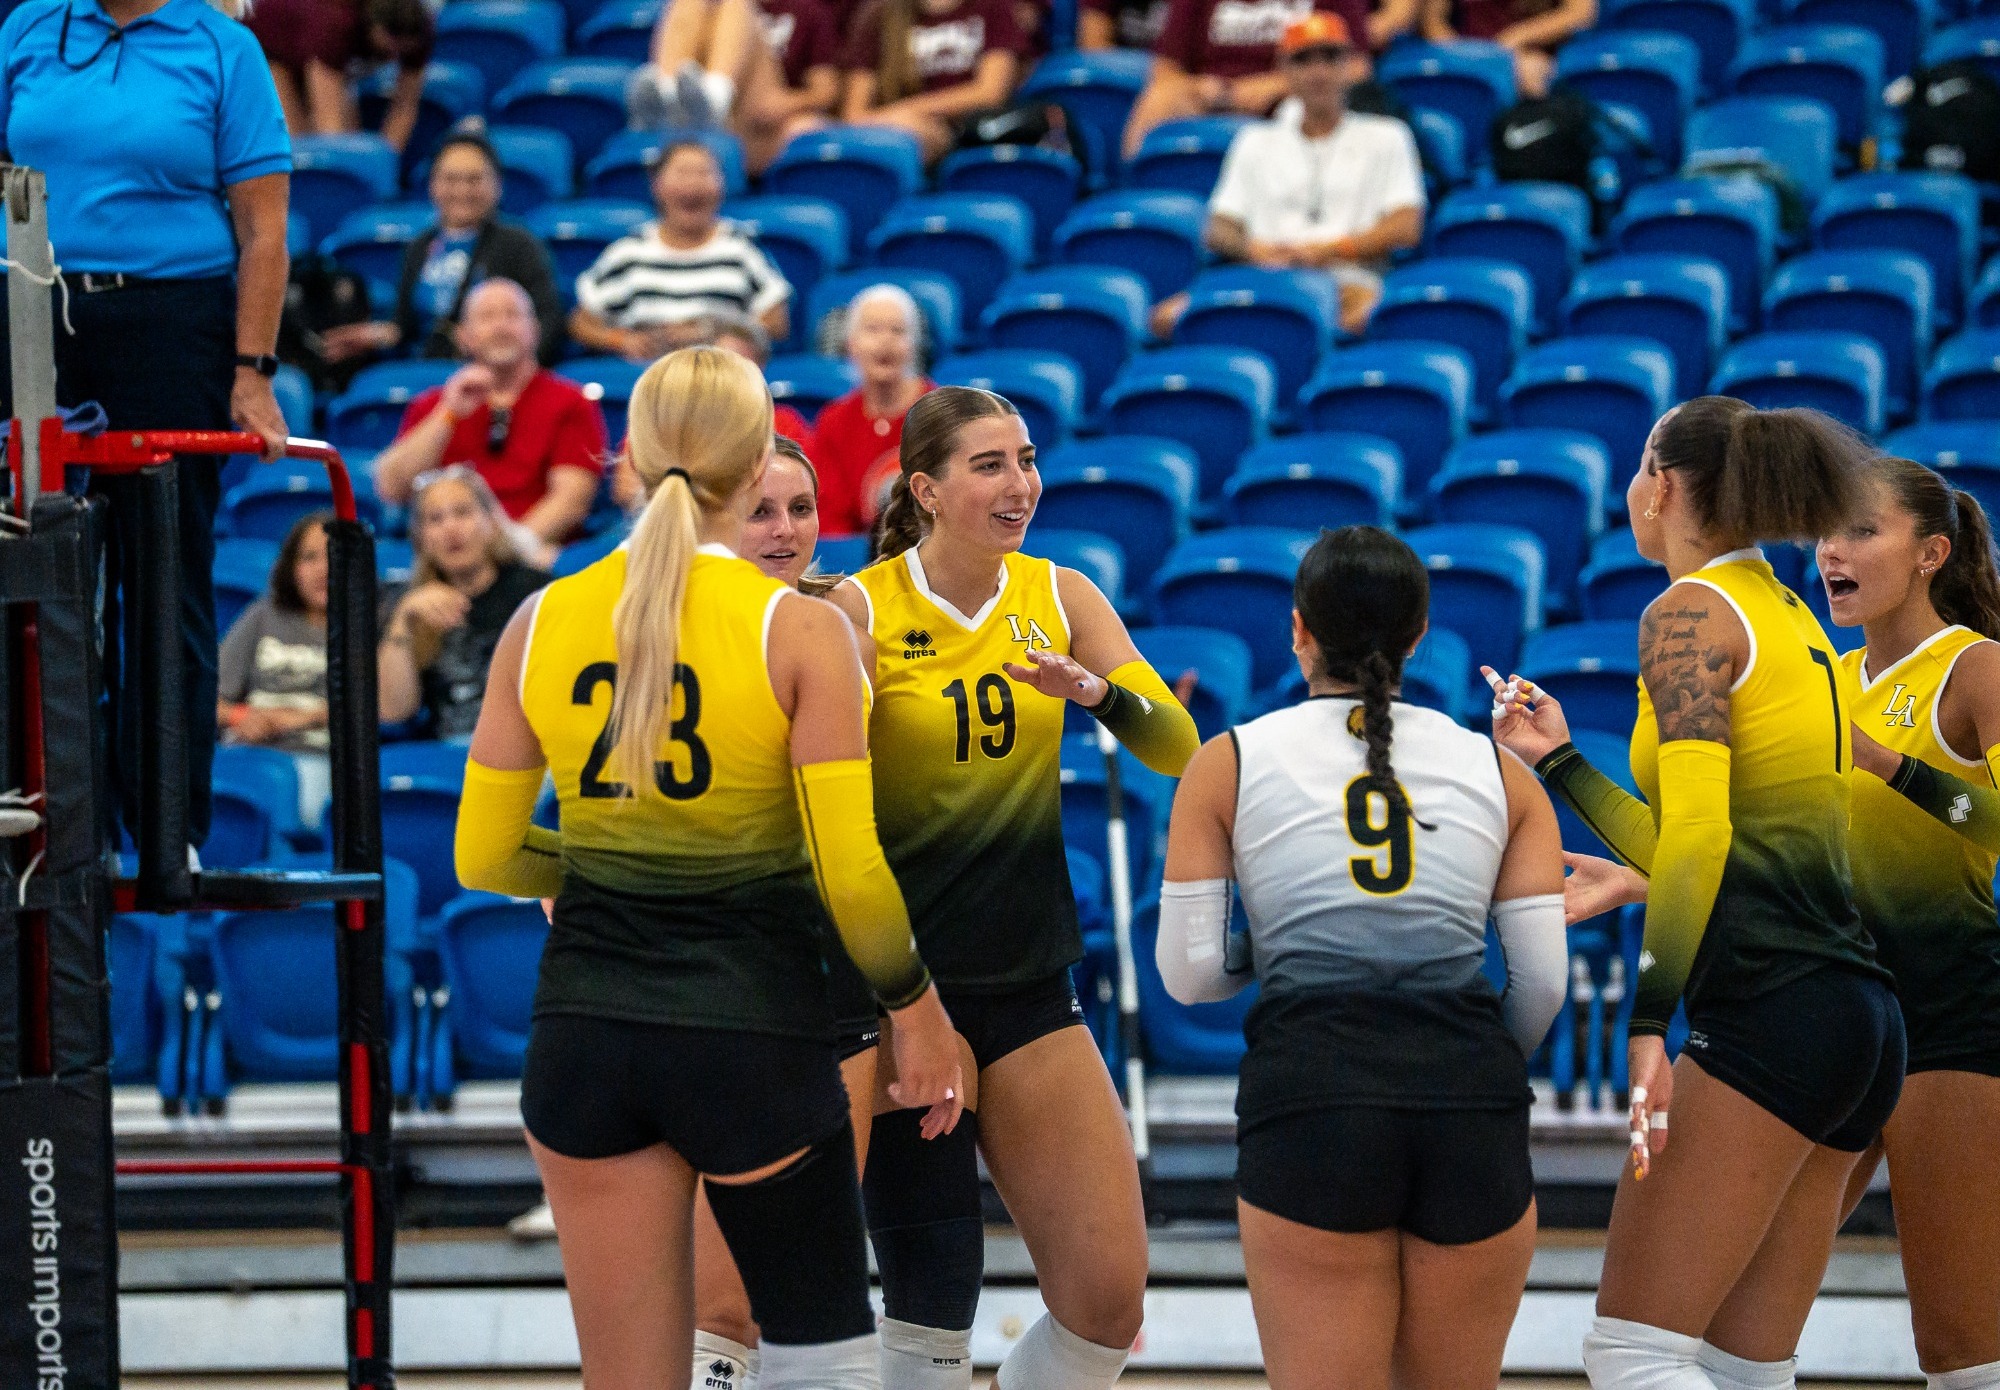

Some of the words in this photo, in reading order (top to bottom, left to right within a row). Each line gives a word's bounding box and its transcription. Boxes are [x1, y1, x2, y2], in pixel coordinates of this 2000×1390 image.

[1005, 615, 1052, 653] LA
[571, 660, 713, 801] 23
[941, 673, 1017, 764] 19
[1881, 684, 1917, 728] LA
[1343, 770, 1415, 898] 9
[21, 1137, 62, 1252] sports
